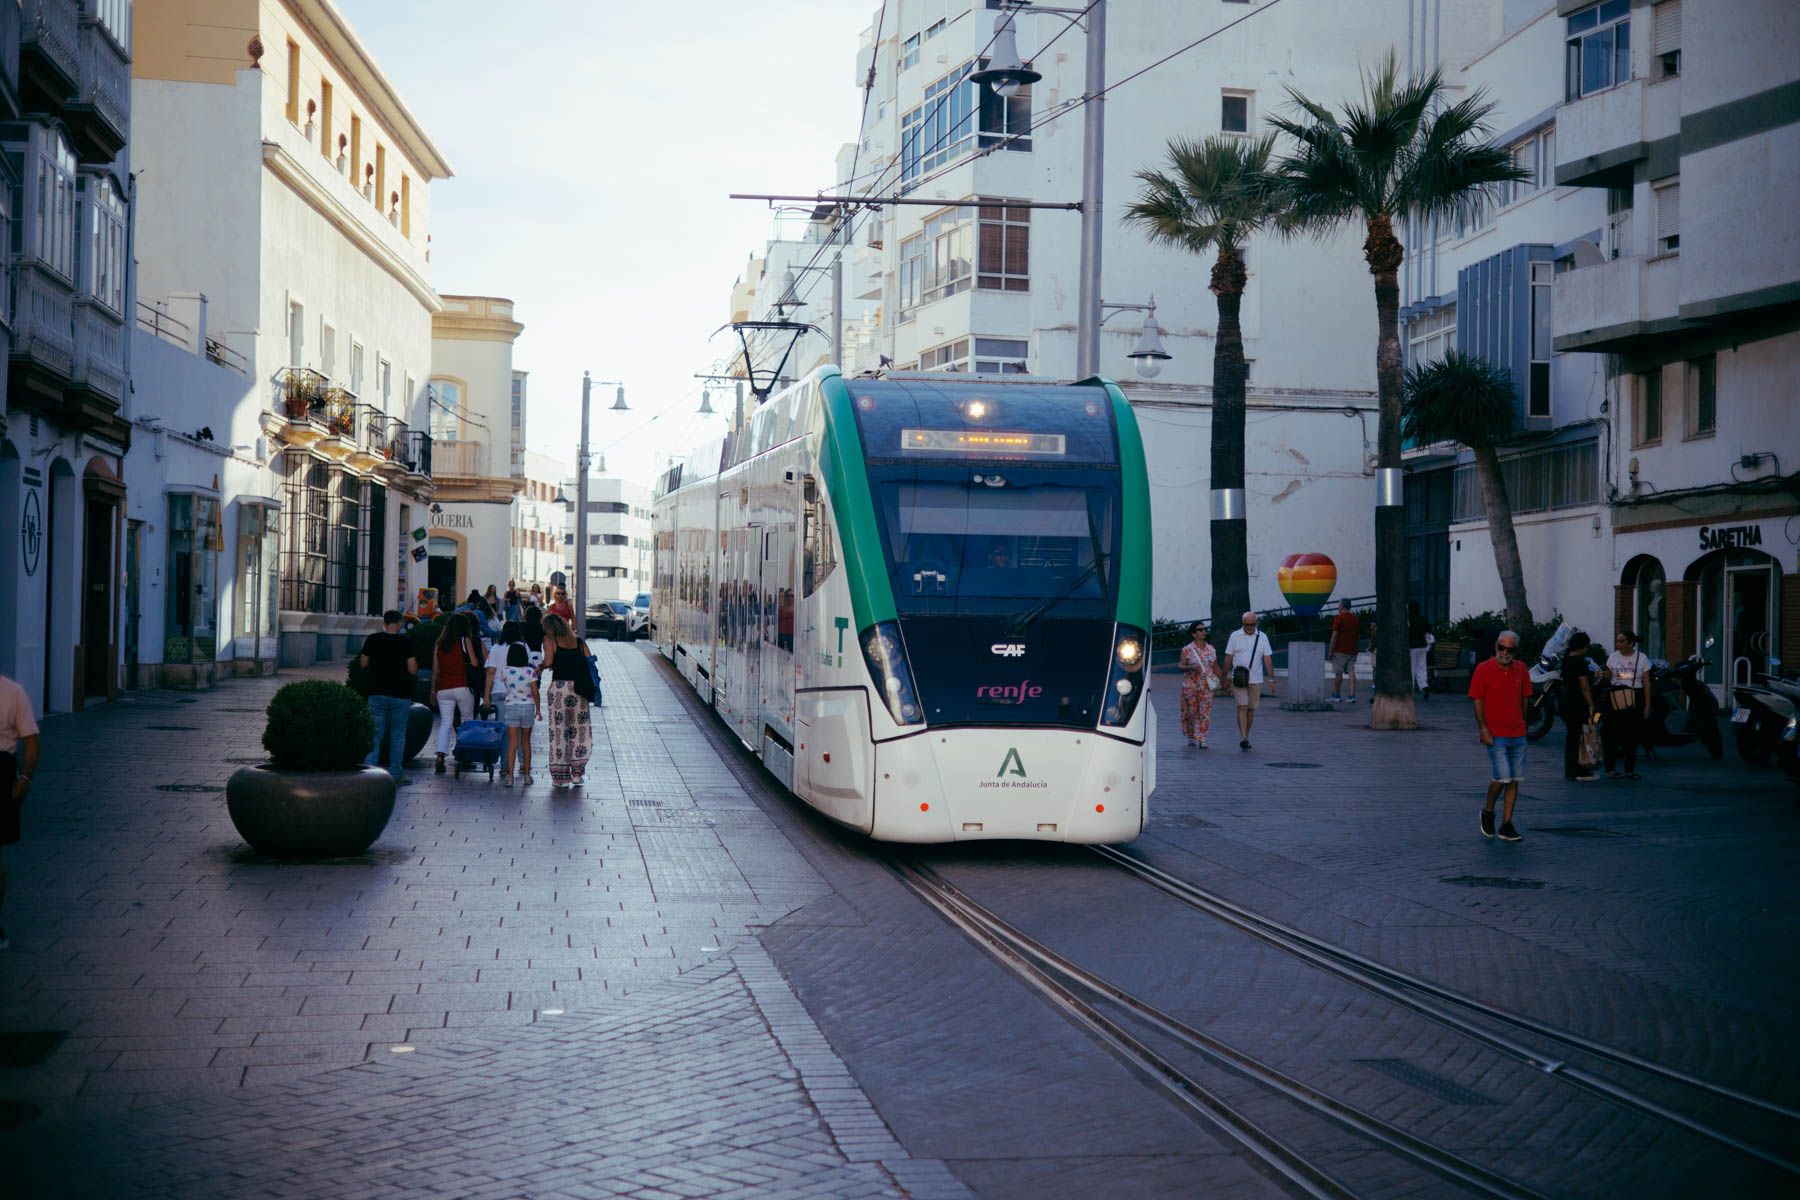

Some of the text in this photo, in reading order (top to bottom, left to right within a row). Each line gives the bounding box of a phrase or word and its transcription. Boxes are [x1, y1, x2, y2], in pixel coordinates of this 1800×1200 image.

[430, 513, 474, 528] QUERIA
[1699, 524, 1762, 550] SARETHA
[991, 644, 1026, 657] CAF
[977, 679, 1043, 705] renfe
